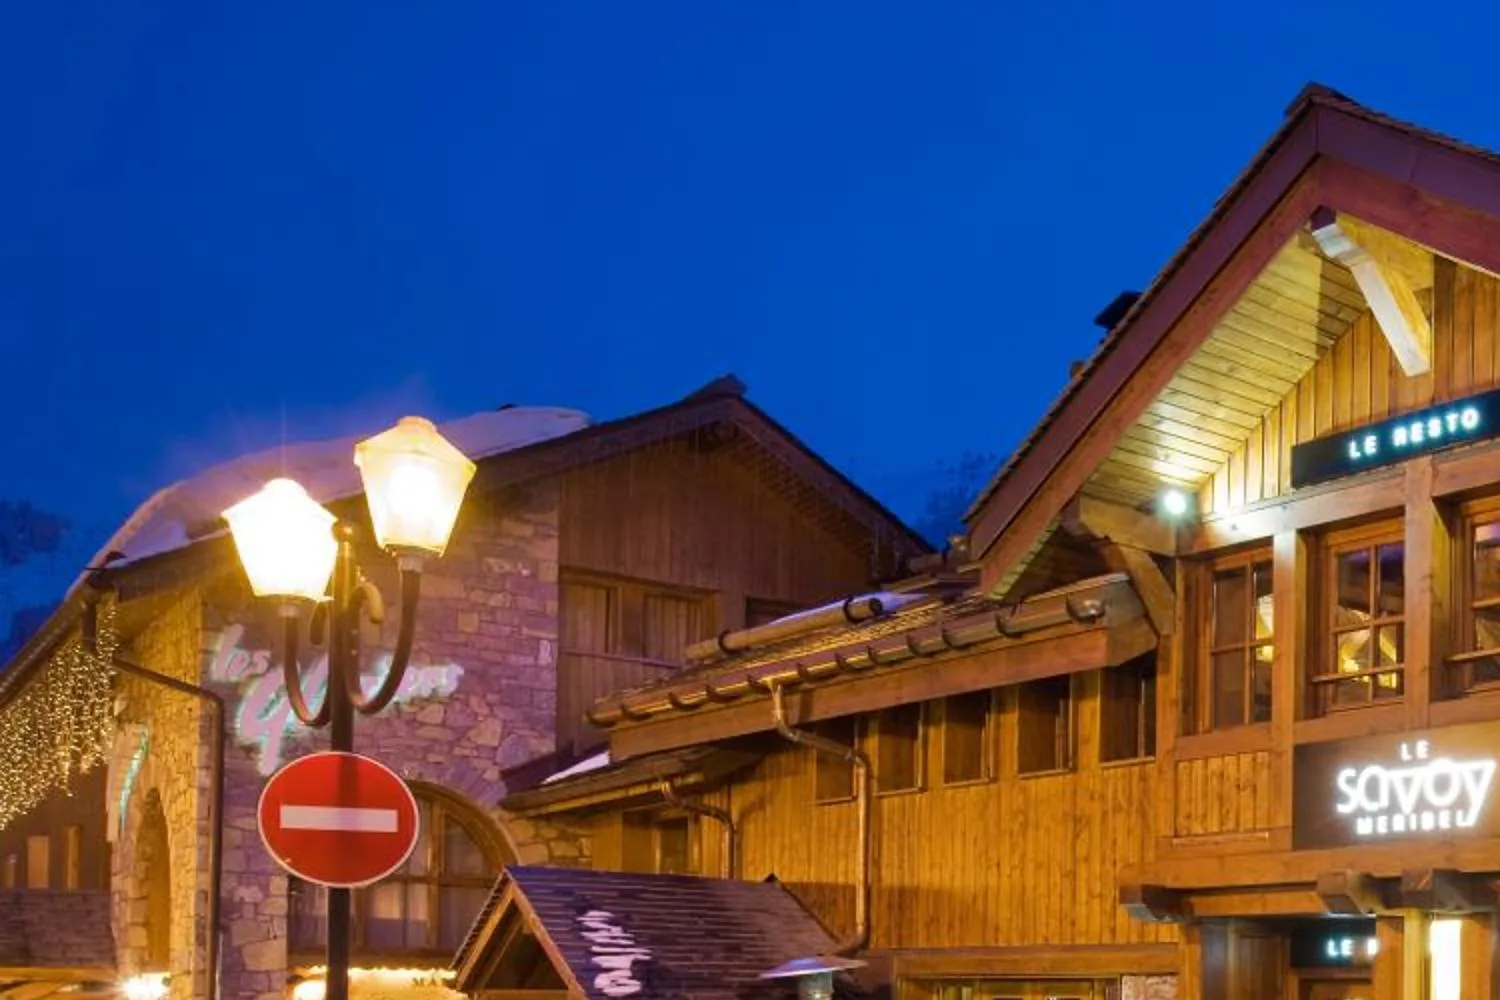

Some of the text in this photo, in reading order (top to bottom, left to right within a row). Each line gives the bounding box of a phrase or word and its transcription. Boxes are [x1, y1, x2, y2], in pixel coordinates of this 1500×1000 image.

[1349, 406, 1480, 459] LE RESTO
[1401, 740, 1429, 761] LE
[1326, 938, 1352, 958] LE
